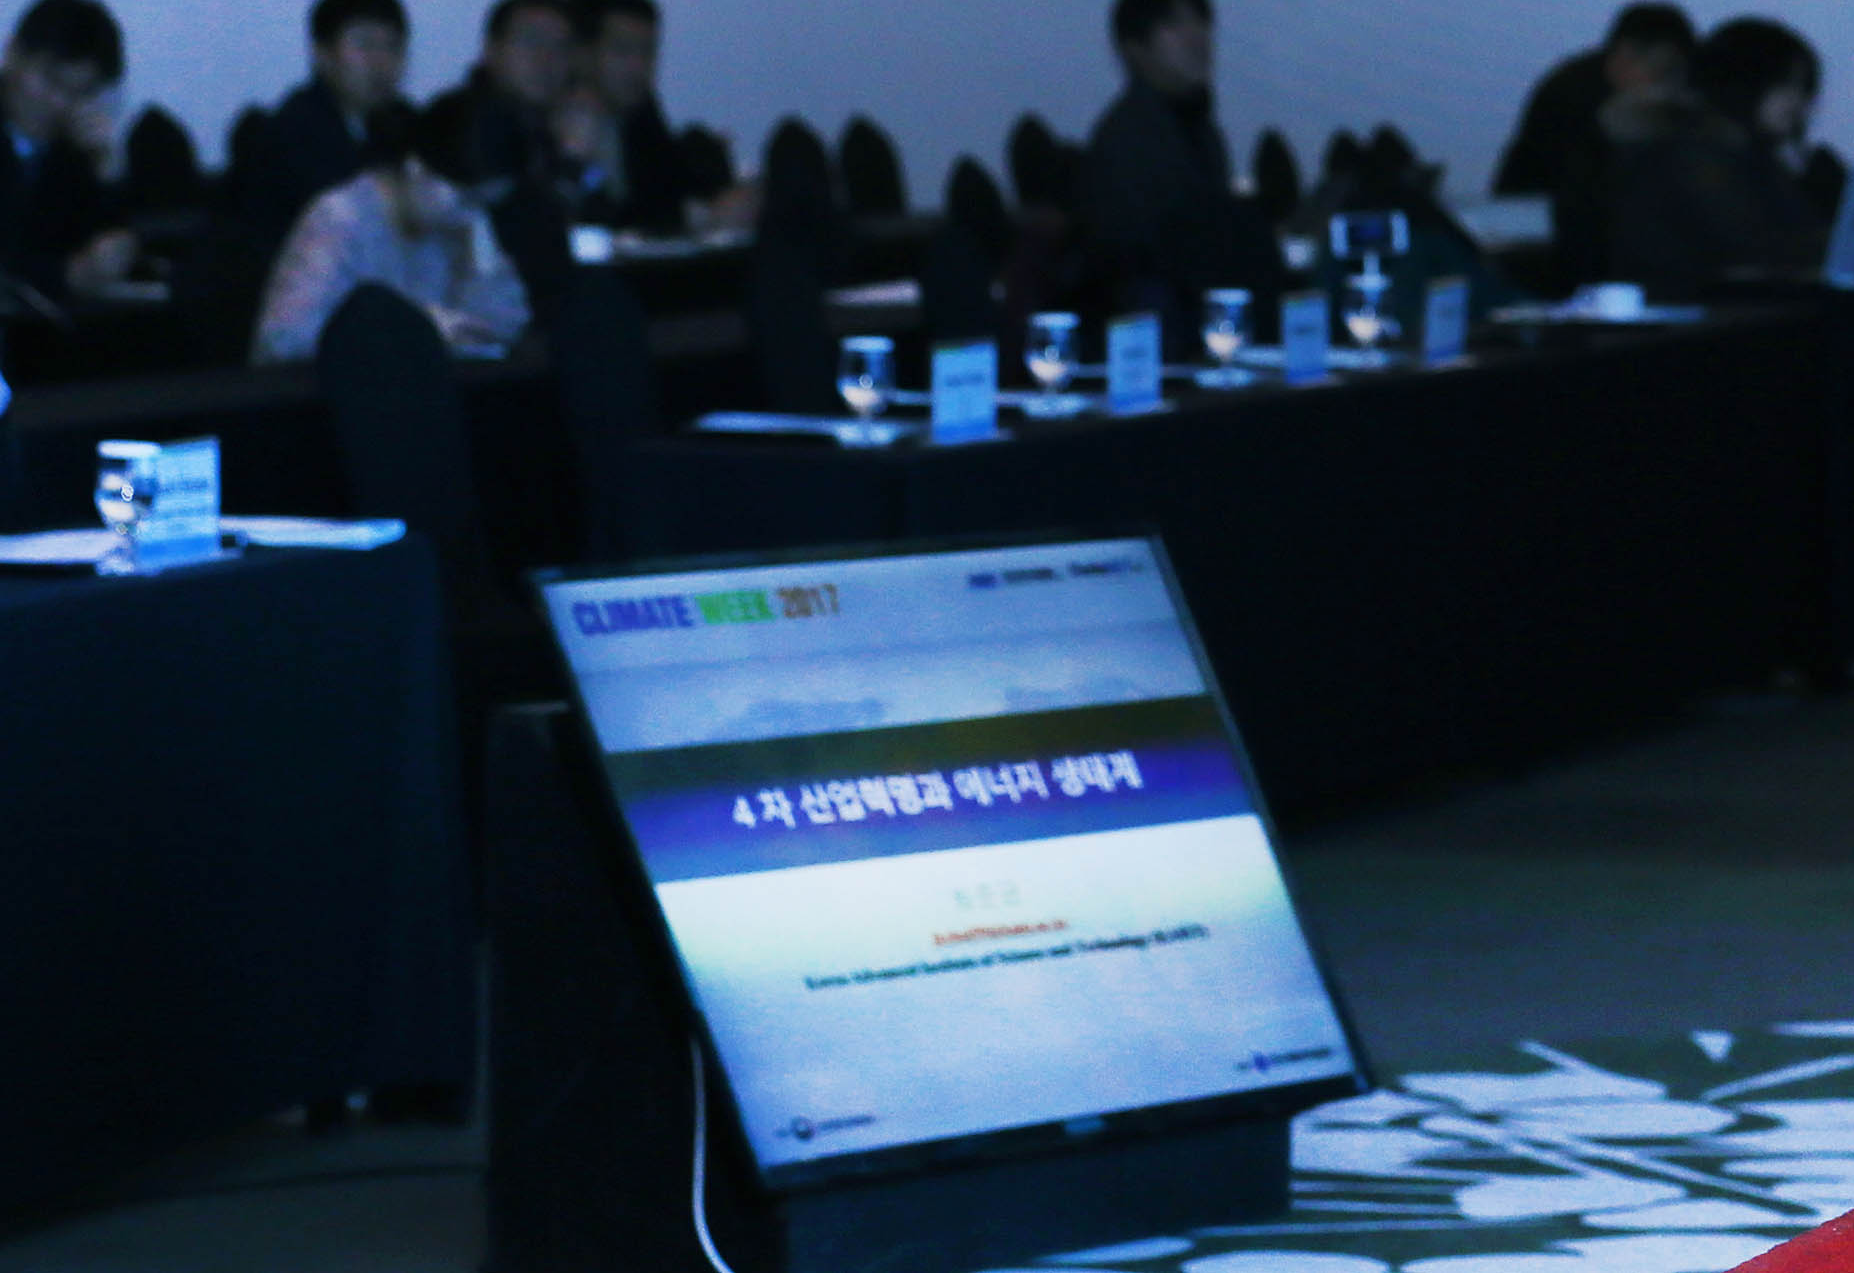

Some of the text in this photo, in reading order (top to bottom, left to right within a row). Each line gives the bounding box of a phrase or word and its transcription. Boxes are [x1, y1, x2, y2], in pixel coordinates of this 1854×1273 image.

[572, 582, 840, 636] CLIMATE WEEK 2017
